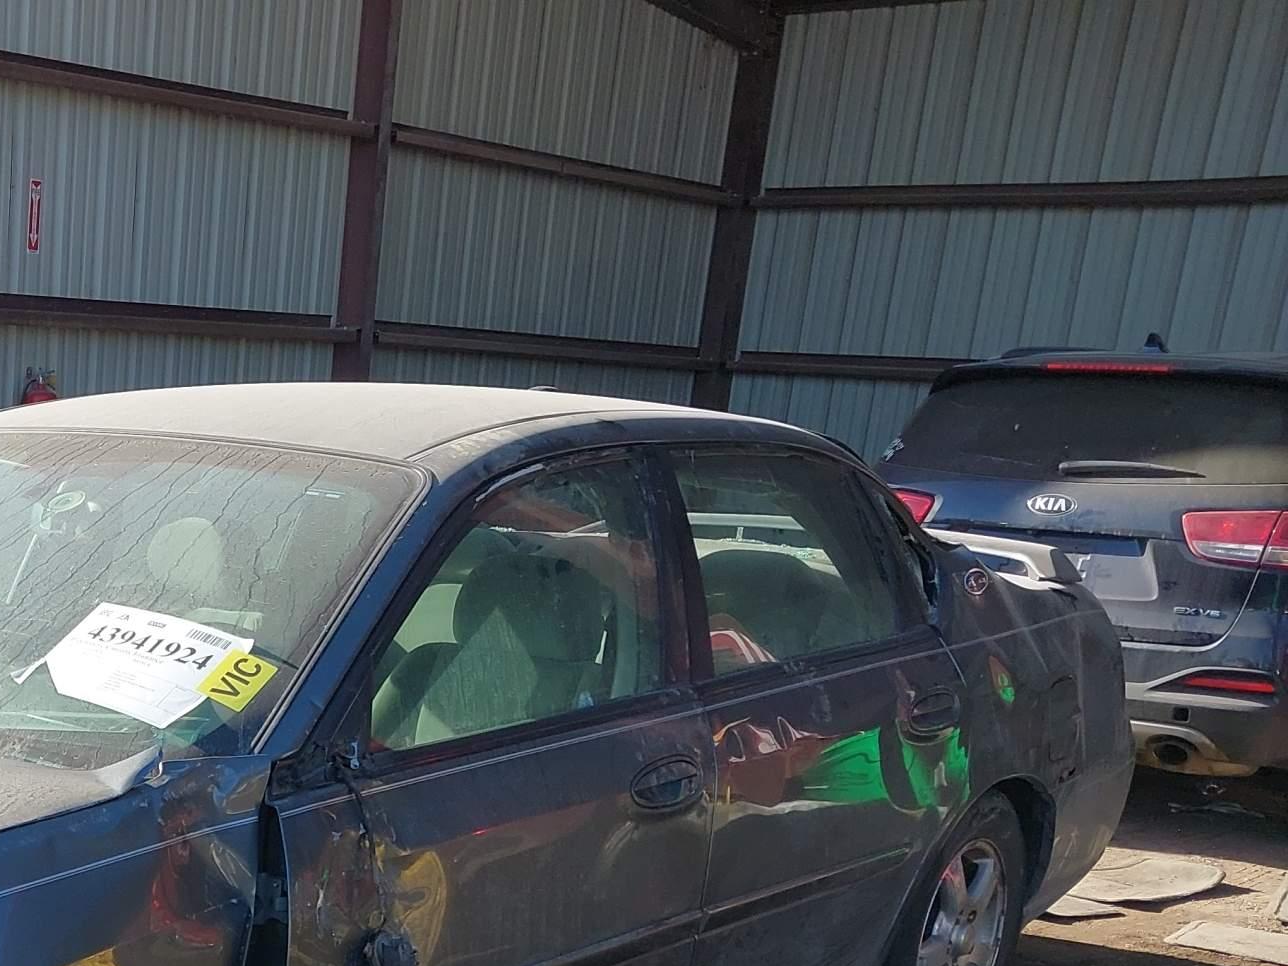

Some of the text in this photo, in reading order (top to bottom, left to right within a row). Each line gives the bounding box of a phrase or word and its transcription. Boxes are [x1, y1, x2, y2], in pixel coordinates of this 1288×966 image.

[1035, 497, 1066, 511] KIA
[1174, 606, 1197, 616] EX
[88, 625, 214, 670] 43941924
[209, 658, 262, 698] VIC
